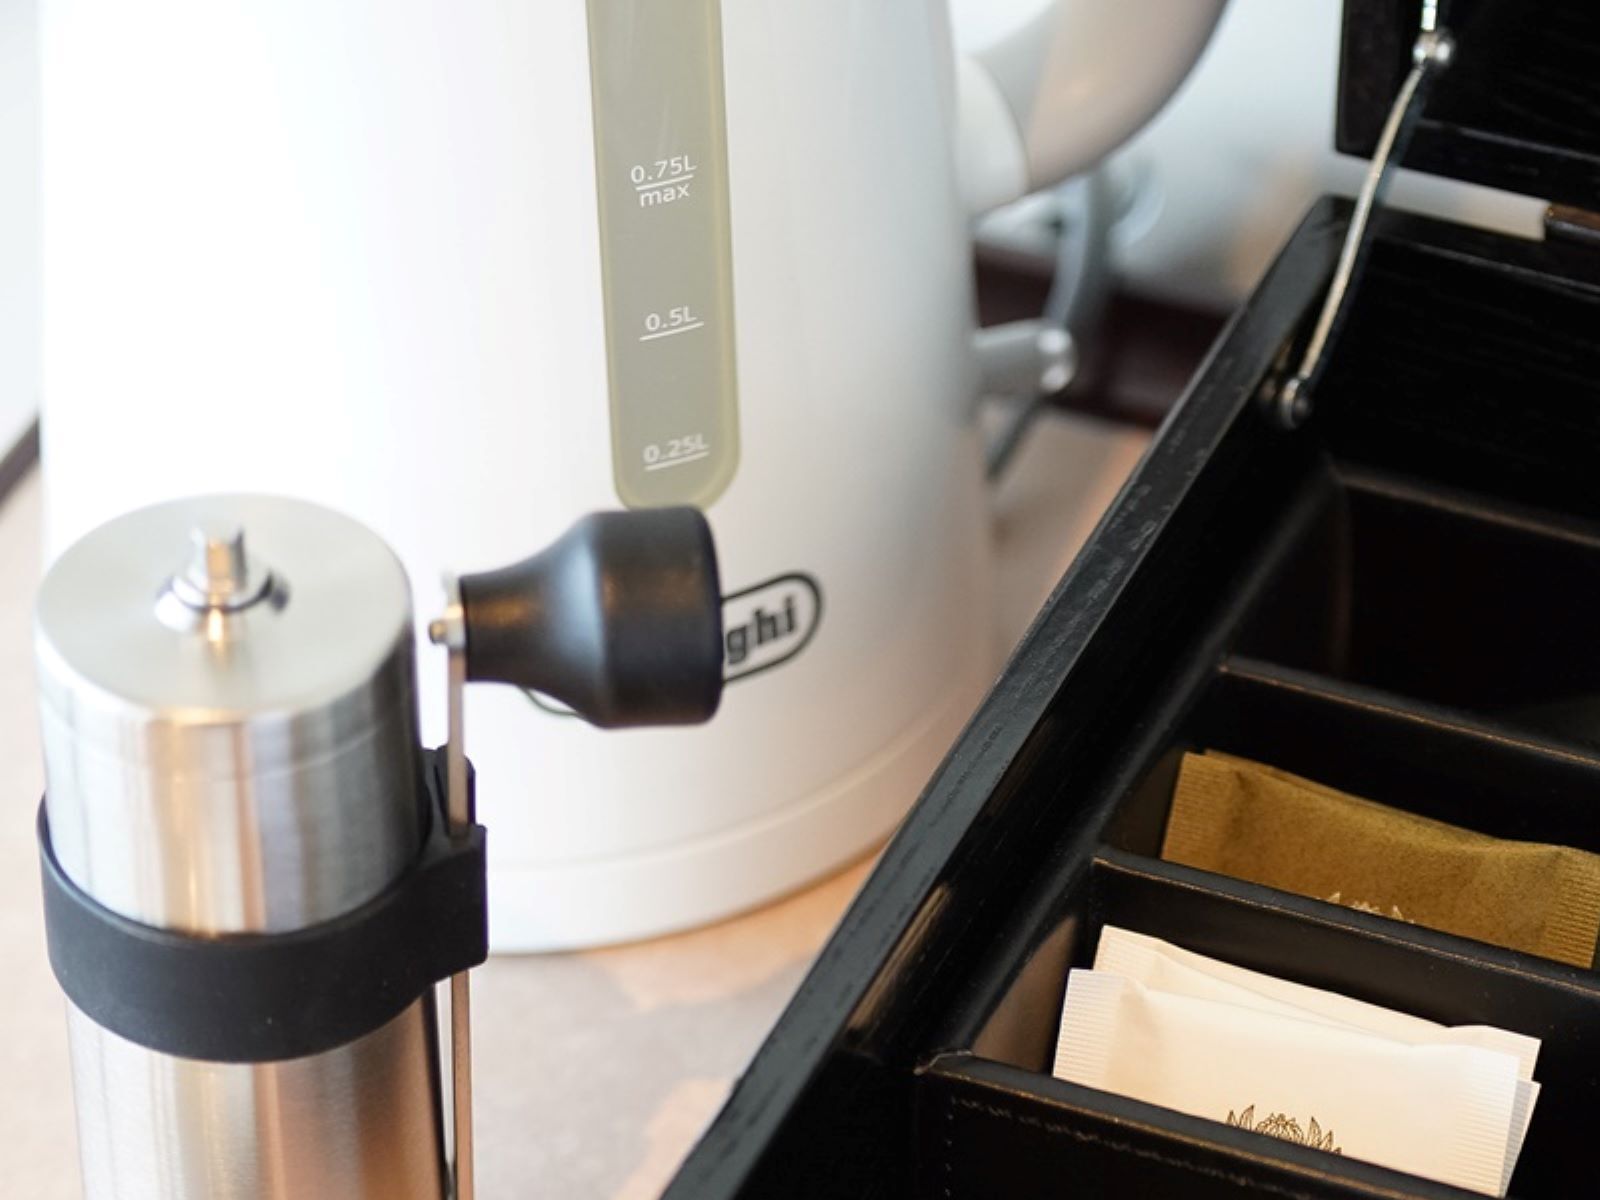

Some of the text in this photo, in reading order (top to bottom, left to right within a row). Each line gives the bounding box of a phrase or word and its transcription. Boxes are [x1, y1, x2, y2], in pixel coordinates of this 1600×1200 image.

[631, 155, 697, 184] 0.75L
[639, 184, 691, 207] max
[645, 306, 696, 332] 0.5L
[643, 434, 708, 463] 0.25L
